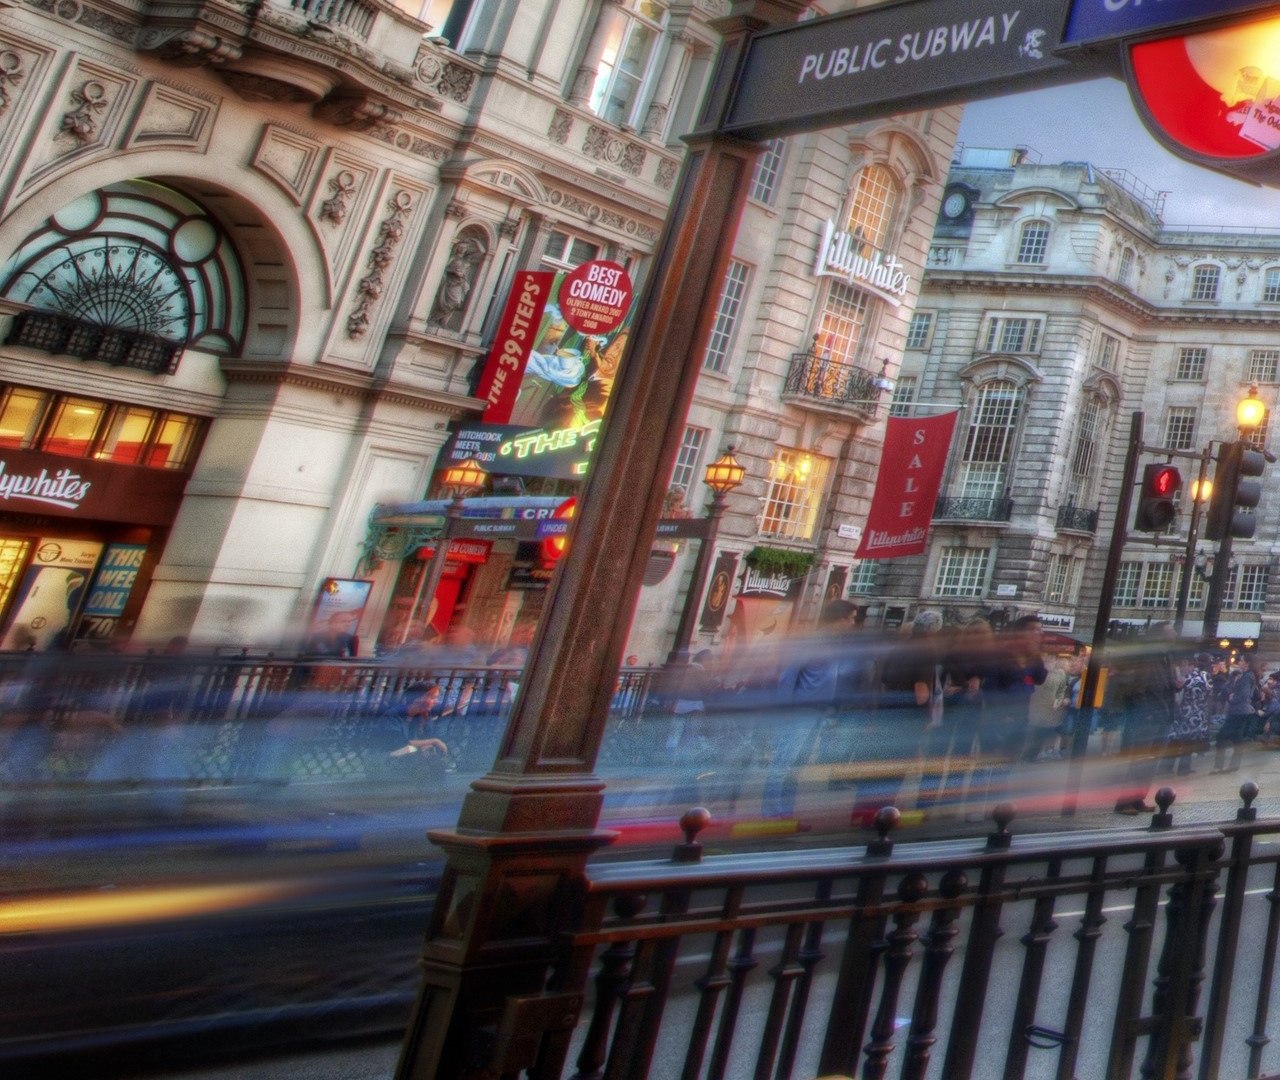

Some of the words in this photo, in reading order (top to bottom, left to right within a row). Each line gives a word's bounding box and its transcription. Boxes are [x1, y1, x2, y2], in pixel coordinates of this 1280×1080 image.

[799, 39, 892, 84] PUBLIC
[894, 11, 1020, 64] SUBWAY
[1253, 108, 1267, 124] The
[814, 218, 911, 296] Lillywhites
[587, 264, 623, 287] BEST
[570, 280, 627, 308] COMEDY
[566, 297, 590, 311] OLIVIER
[589, 302, 609, 315] AWARD
[576, 308, 591, 320] TONY
[591, 312, 613, 324] AWARDS
[499, 340, 523, 371] 39
[455, 441, 481, 452] MEETS
[459, 430, 503, 442] HITCHCOCK
[452, 450, 495, 462] HILAOUS!
[899, 429, 926, 518] SALE
[866, 527, 926, 549] Lillywhites
[743, 567, 792, 594] Lillywhites
